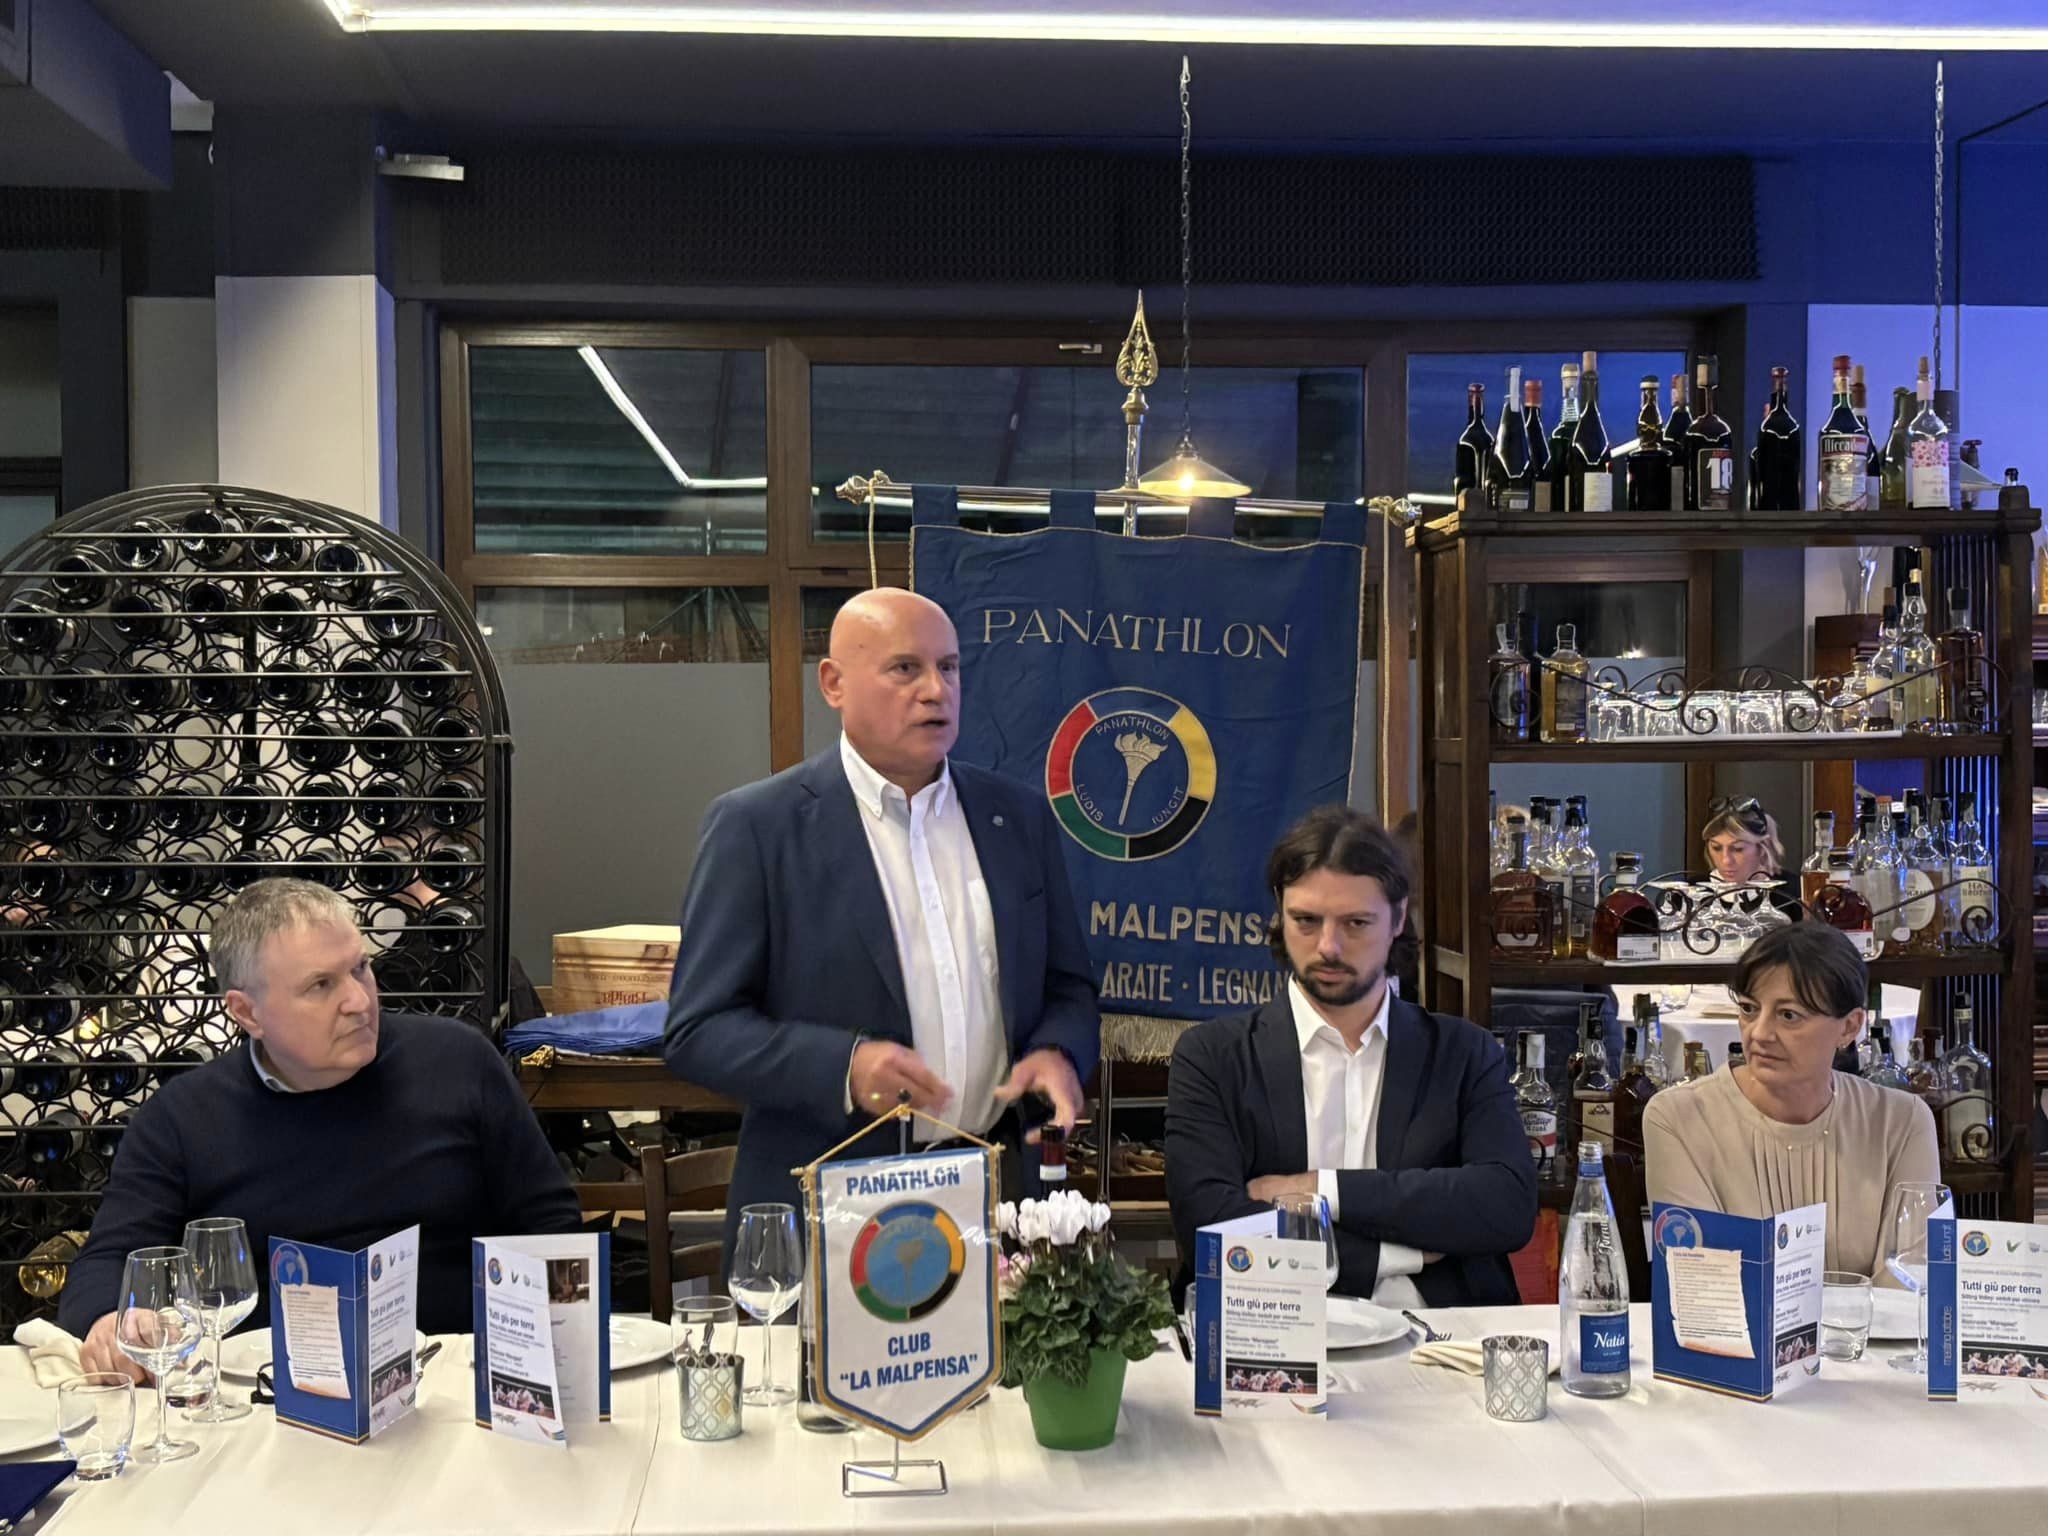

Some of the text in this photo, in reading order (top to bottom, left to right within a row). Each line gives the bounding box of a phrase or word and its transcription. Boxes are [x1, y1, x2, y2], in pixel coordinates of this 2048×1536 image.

[983, 608, 1293, 659] PANATHLON
[1095, 716, 1170, 741] PANATHLON
[1077, 783, 1104, 822] LUDIS
[1151, 786, 1184, 825] IUNGIT
[1098, 961, 1289, 1005] ARATE LEGNAN
[847, 1166, 960, 1196] PANATHLON
[1961, 1280, 2041, 1295] Tutti giù per terra
[1226, 1296, 1301, 1312] Tutti giù per terra
[888, 1333, 931, 1357] CLUB
[1593, 1332, 1625, 1348] Natia
[840, 1354, 978, 1391] “LA MALPENSA”
